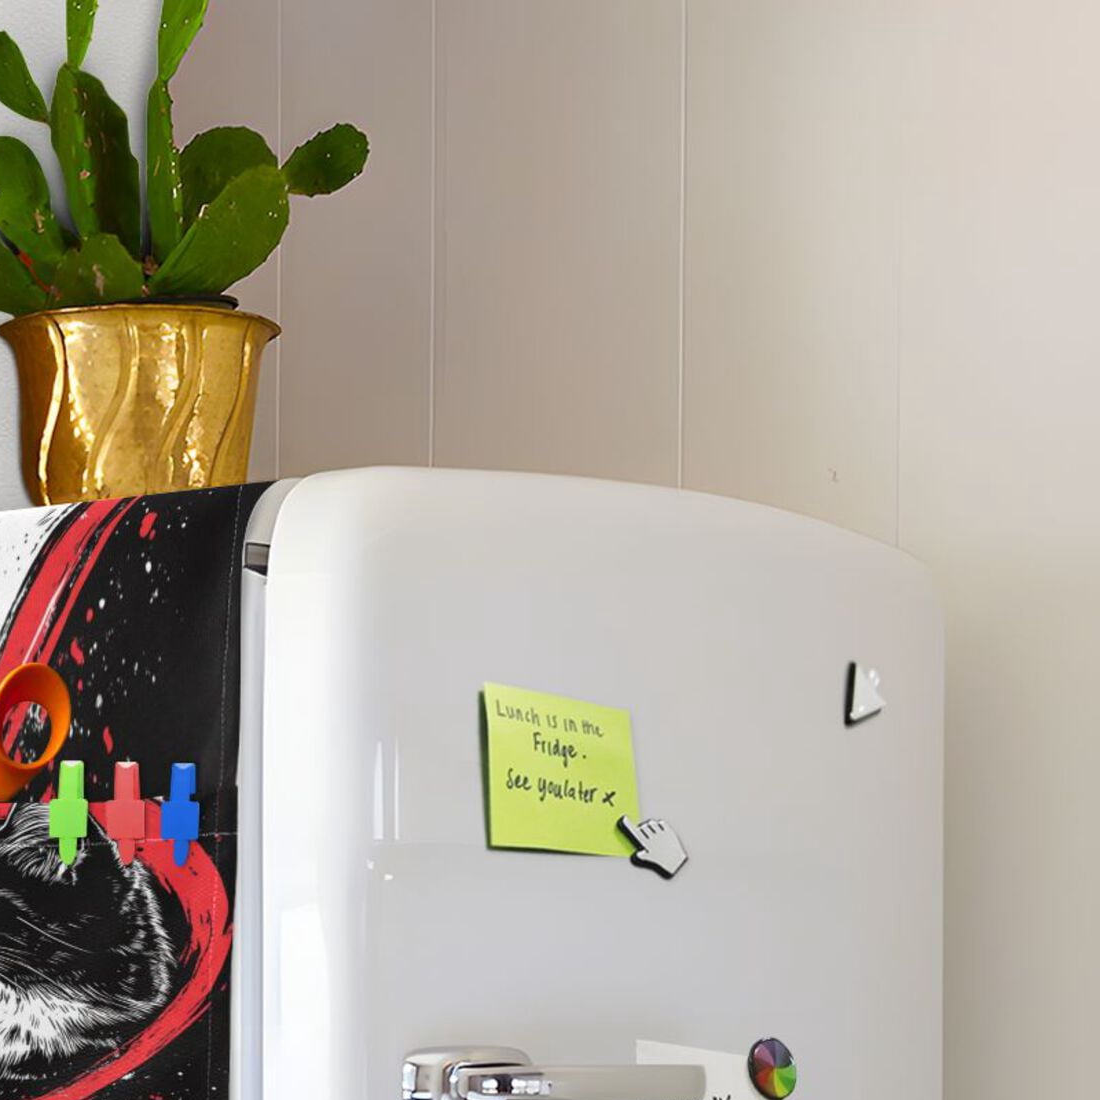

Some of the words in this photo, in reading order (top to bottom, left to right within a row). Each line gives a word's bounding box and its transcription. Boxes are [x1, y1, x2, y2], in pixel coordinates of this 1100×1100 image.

[495, 699, 540, 727] Lunch
[546, 714, 558, 729] is
[563, 718, 578, 732] in
[581, 719, 605, 738] the
[506, 767, 532, 790] See
